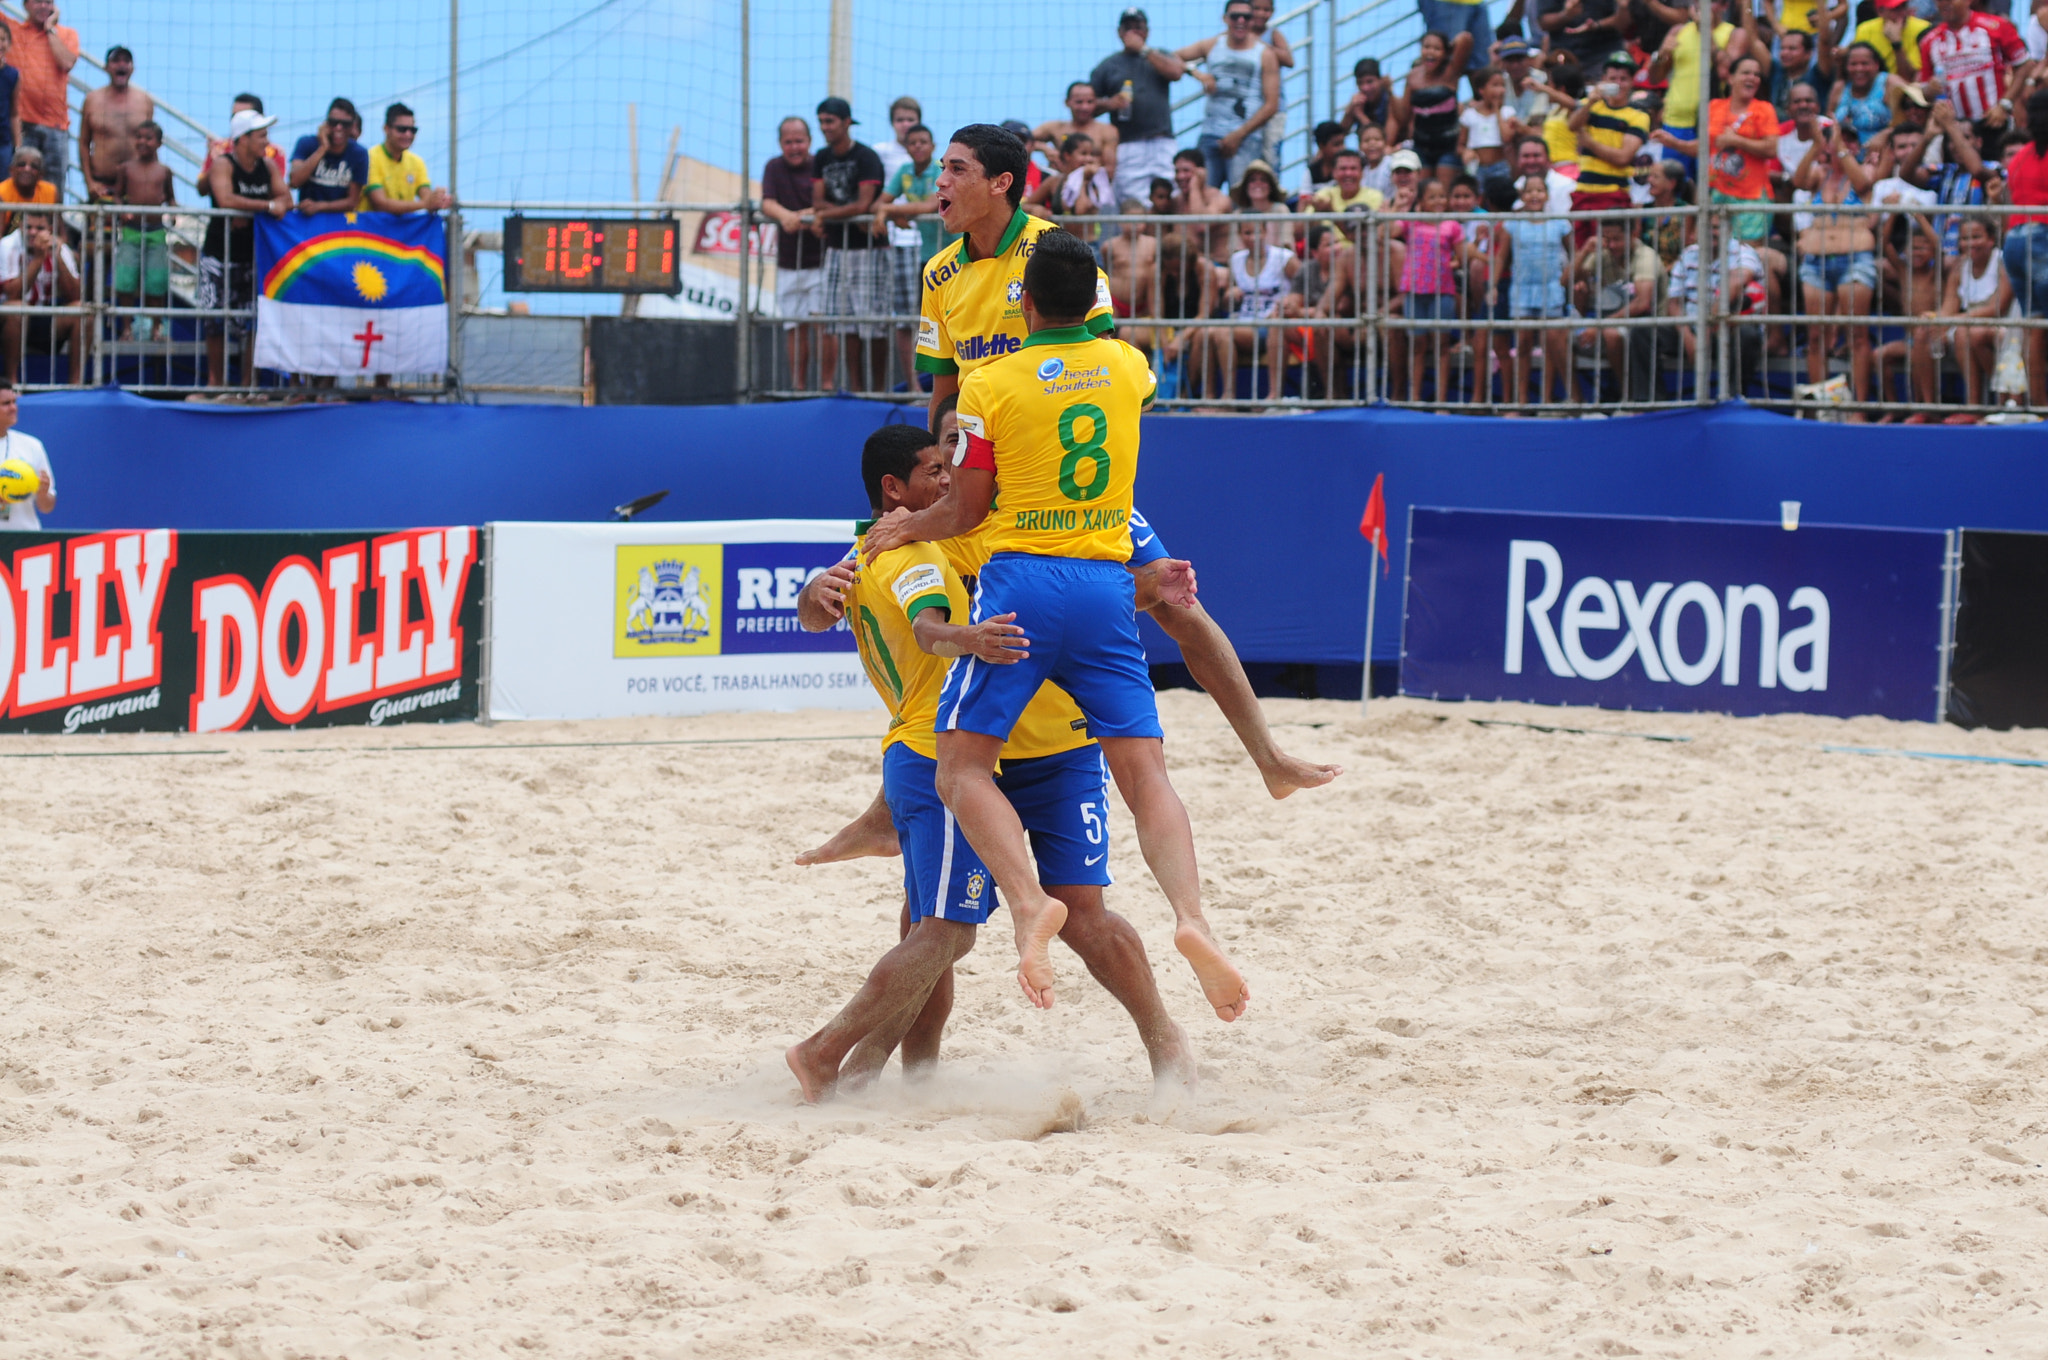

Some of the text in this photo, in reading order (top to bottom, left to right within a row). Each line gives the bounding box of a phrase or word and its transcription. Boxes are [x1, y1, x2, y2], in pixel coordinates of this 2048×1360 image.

[545, 222, 674, 278] 10:11
[1015, 237, 1037, 258] Ita
[955, 332, 1022, 361] Gillette
[1042, 378, 1112, 396] shoulders
[1058, 403, 1110, 501] 8
[1015, 509, 1077, 531] BRUNO
[194, 527, 474, 733] DOLLY
[1504, 539, 1831, 692] Rexona
[369, 679, 461, 726] Guaraná
[627, 678, 658, 693] POR
[712, 673, 824, 691] TRABALHANDO
[828, 673, 857, 688] SEM
[62, 687, 161, 734] Guaraná
[1080, 802, 1103, 845] 5
